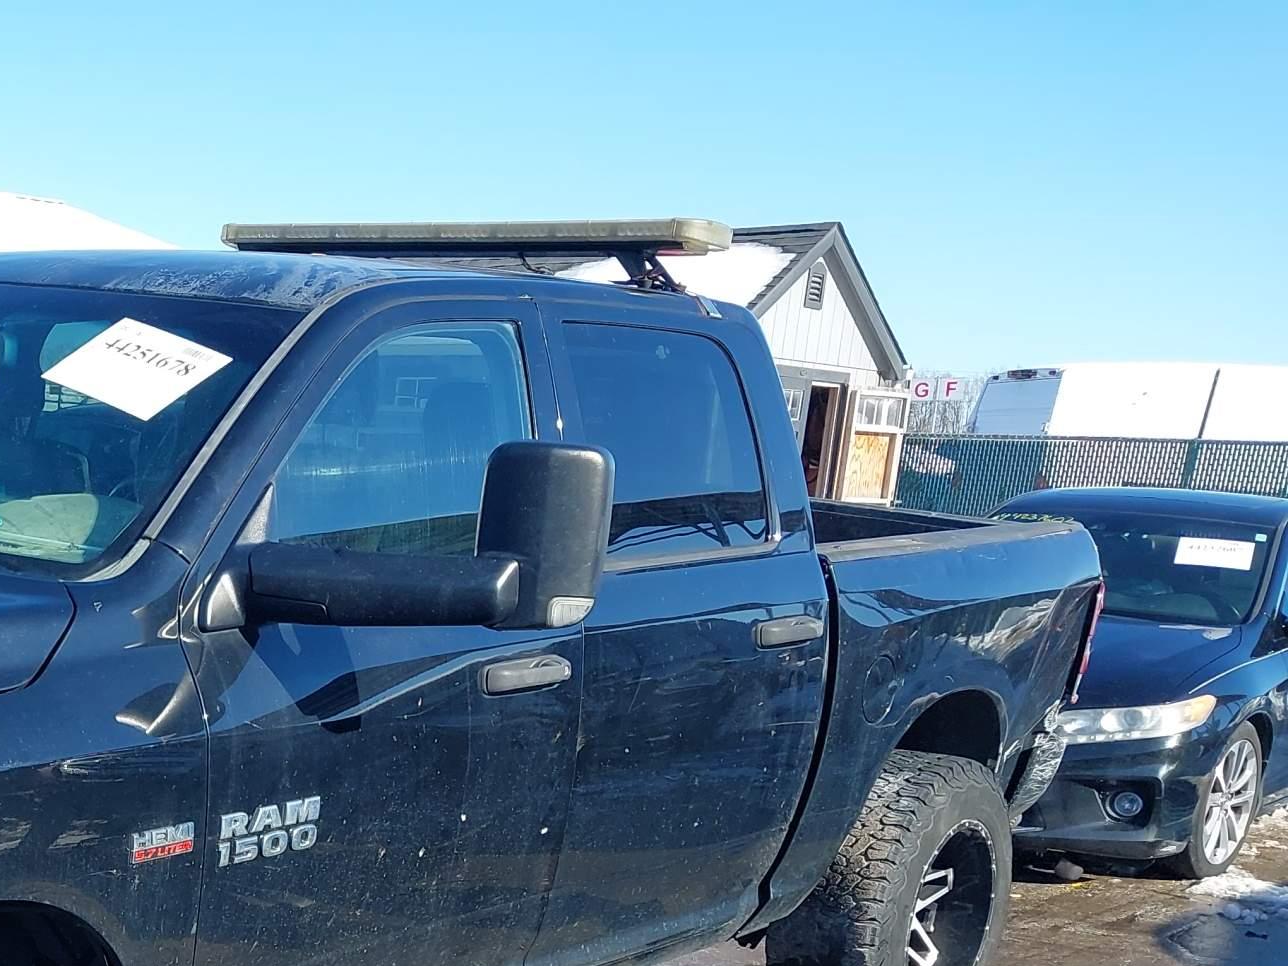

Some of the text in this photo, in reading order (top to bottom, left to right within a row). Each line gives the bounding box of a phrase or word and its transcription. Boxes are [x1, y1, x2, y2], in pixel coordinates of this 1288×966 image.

[104, 338, 197, 377] 44251678
[914, 382, 930, 398] G
[945, 381, 959, 398] F
[220, 796, 321, 841] RAM
[132, 822, 194, 849] HEMI
[217, 823, 318, 868] 1500
